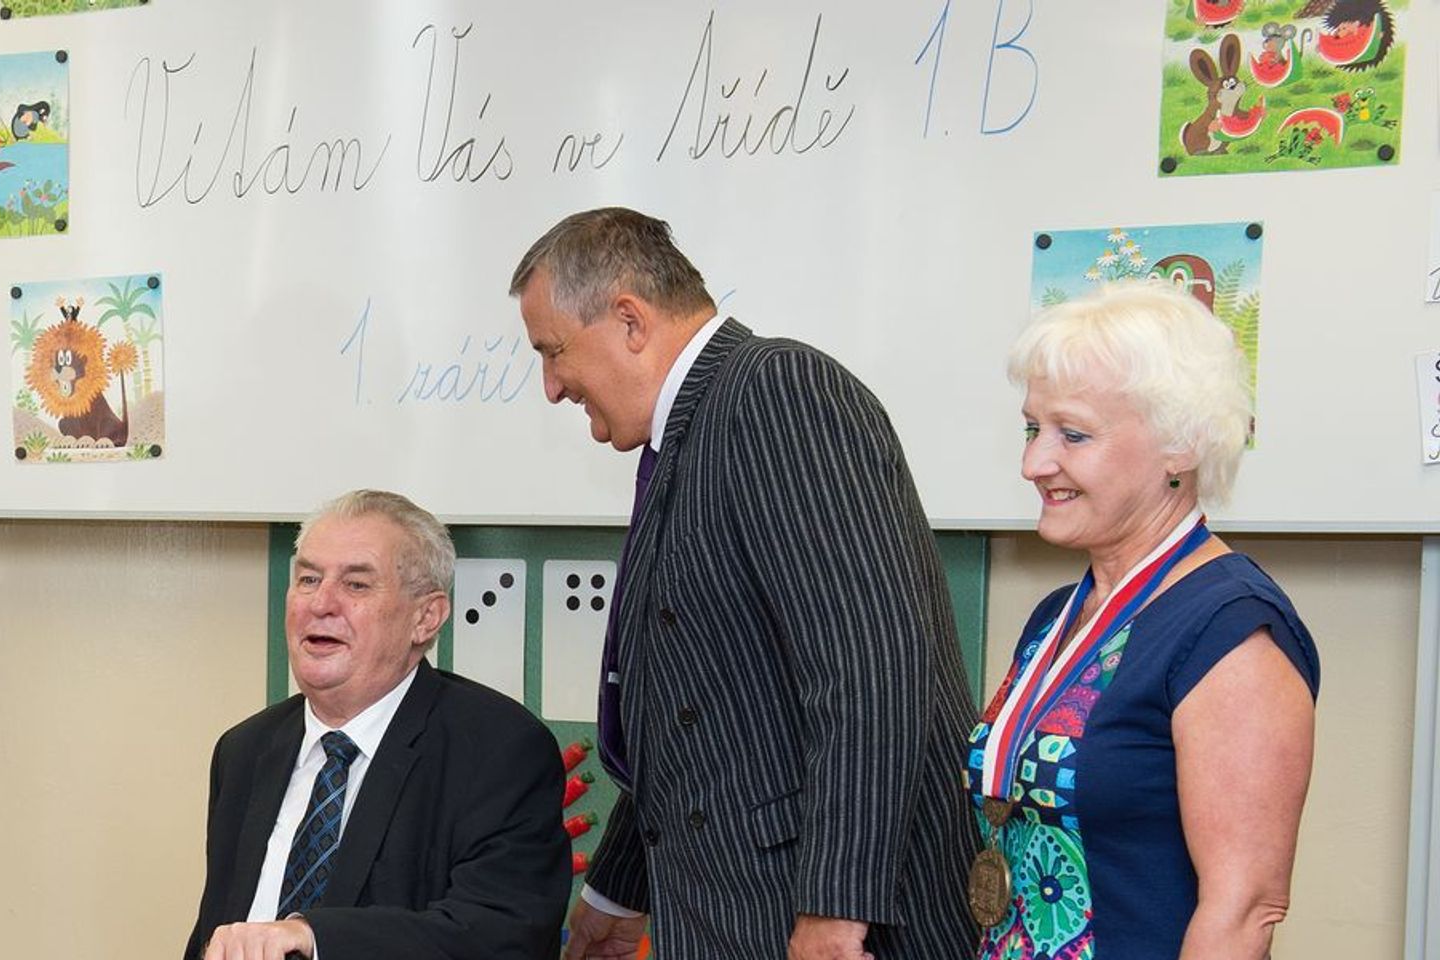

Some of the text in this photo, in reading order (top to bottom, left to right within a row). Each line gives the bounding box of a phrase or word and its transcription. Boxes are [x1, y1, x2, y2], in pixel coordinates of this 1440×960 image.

[412, 22, 514, 183] Vás
[552, 132, 624, 173] ve
[980, 0, 1040, 135] B
